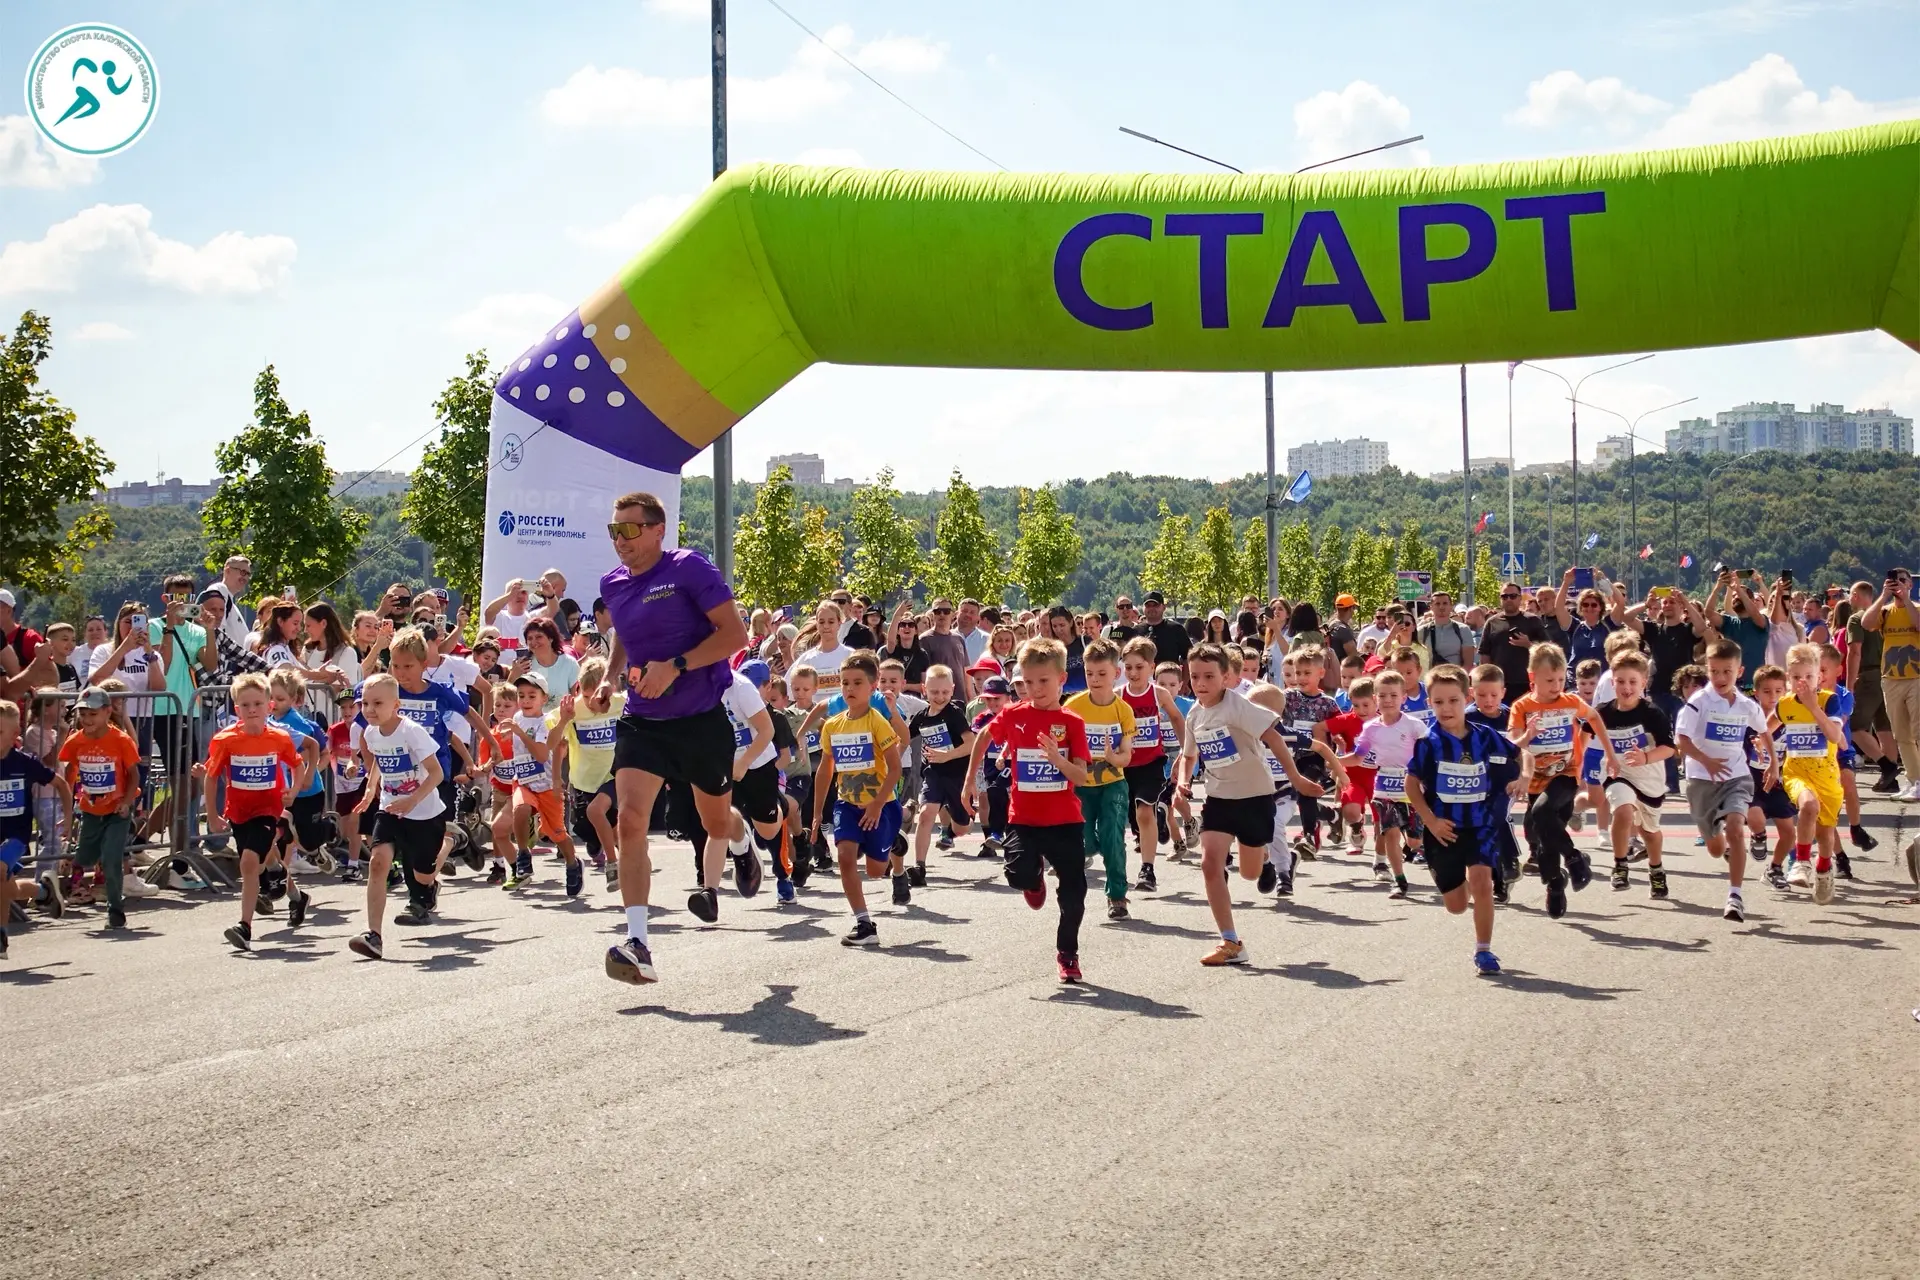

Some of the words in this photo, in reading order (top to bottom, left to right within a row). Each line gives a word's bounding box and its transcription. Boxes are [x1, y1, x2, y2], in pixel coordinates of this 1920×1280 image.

[1053, 191, 1606, 331] СТАРТ
[518, 515, 565, 527] РОССЕТИ
[517, 528, 536, 536] ЦЕНТР
[544, 530, 586, 539] ПРИВОЛЖЬЕ
[650, 585, 667, 593] СПОРТ
[643, 591, 675, 604] КОМАНДА
[124, 665, 146, 674] UMA
[819, 676, 841, 685] 6493
[586, 728, 613, 740] 4170
[1537, 728, 1566, 740] 6299
[1716, 726, 1741, 736] 9901
[1791, 735, 1818, 745] 5072
[836, 746, 863, 758] 7067
[1200, 742, 1225, 755] 9902
[379, 757, 400, 767] 6527
[239, 767, 269, 777] 4455
[1028, 763, 1060, 775] 5725
[83, 773, 107, 782] 5007
[1382, 778, 1405, 787] 4775
[1447, 777, 1481, 788] 9920
